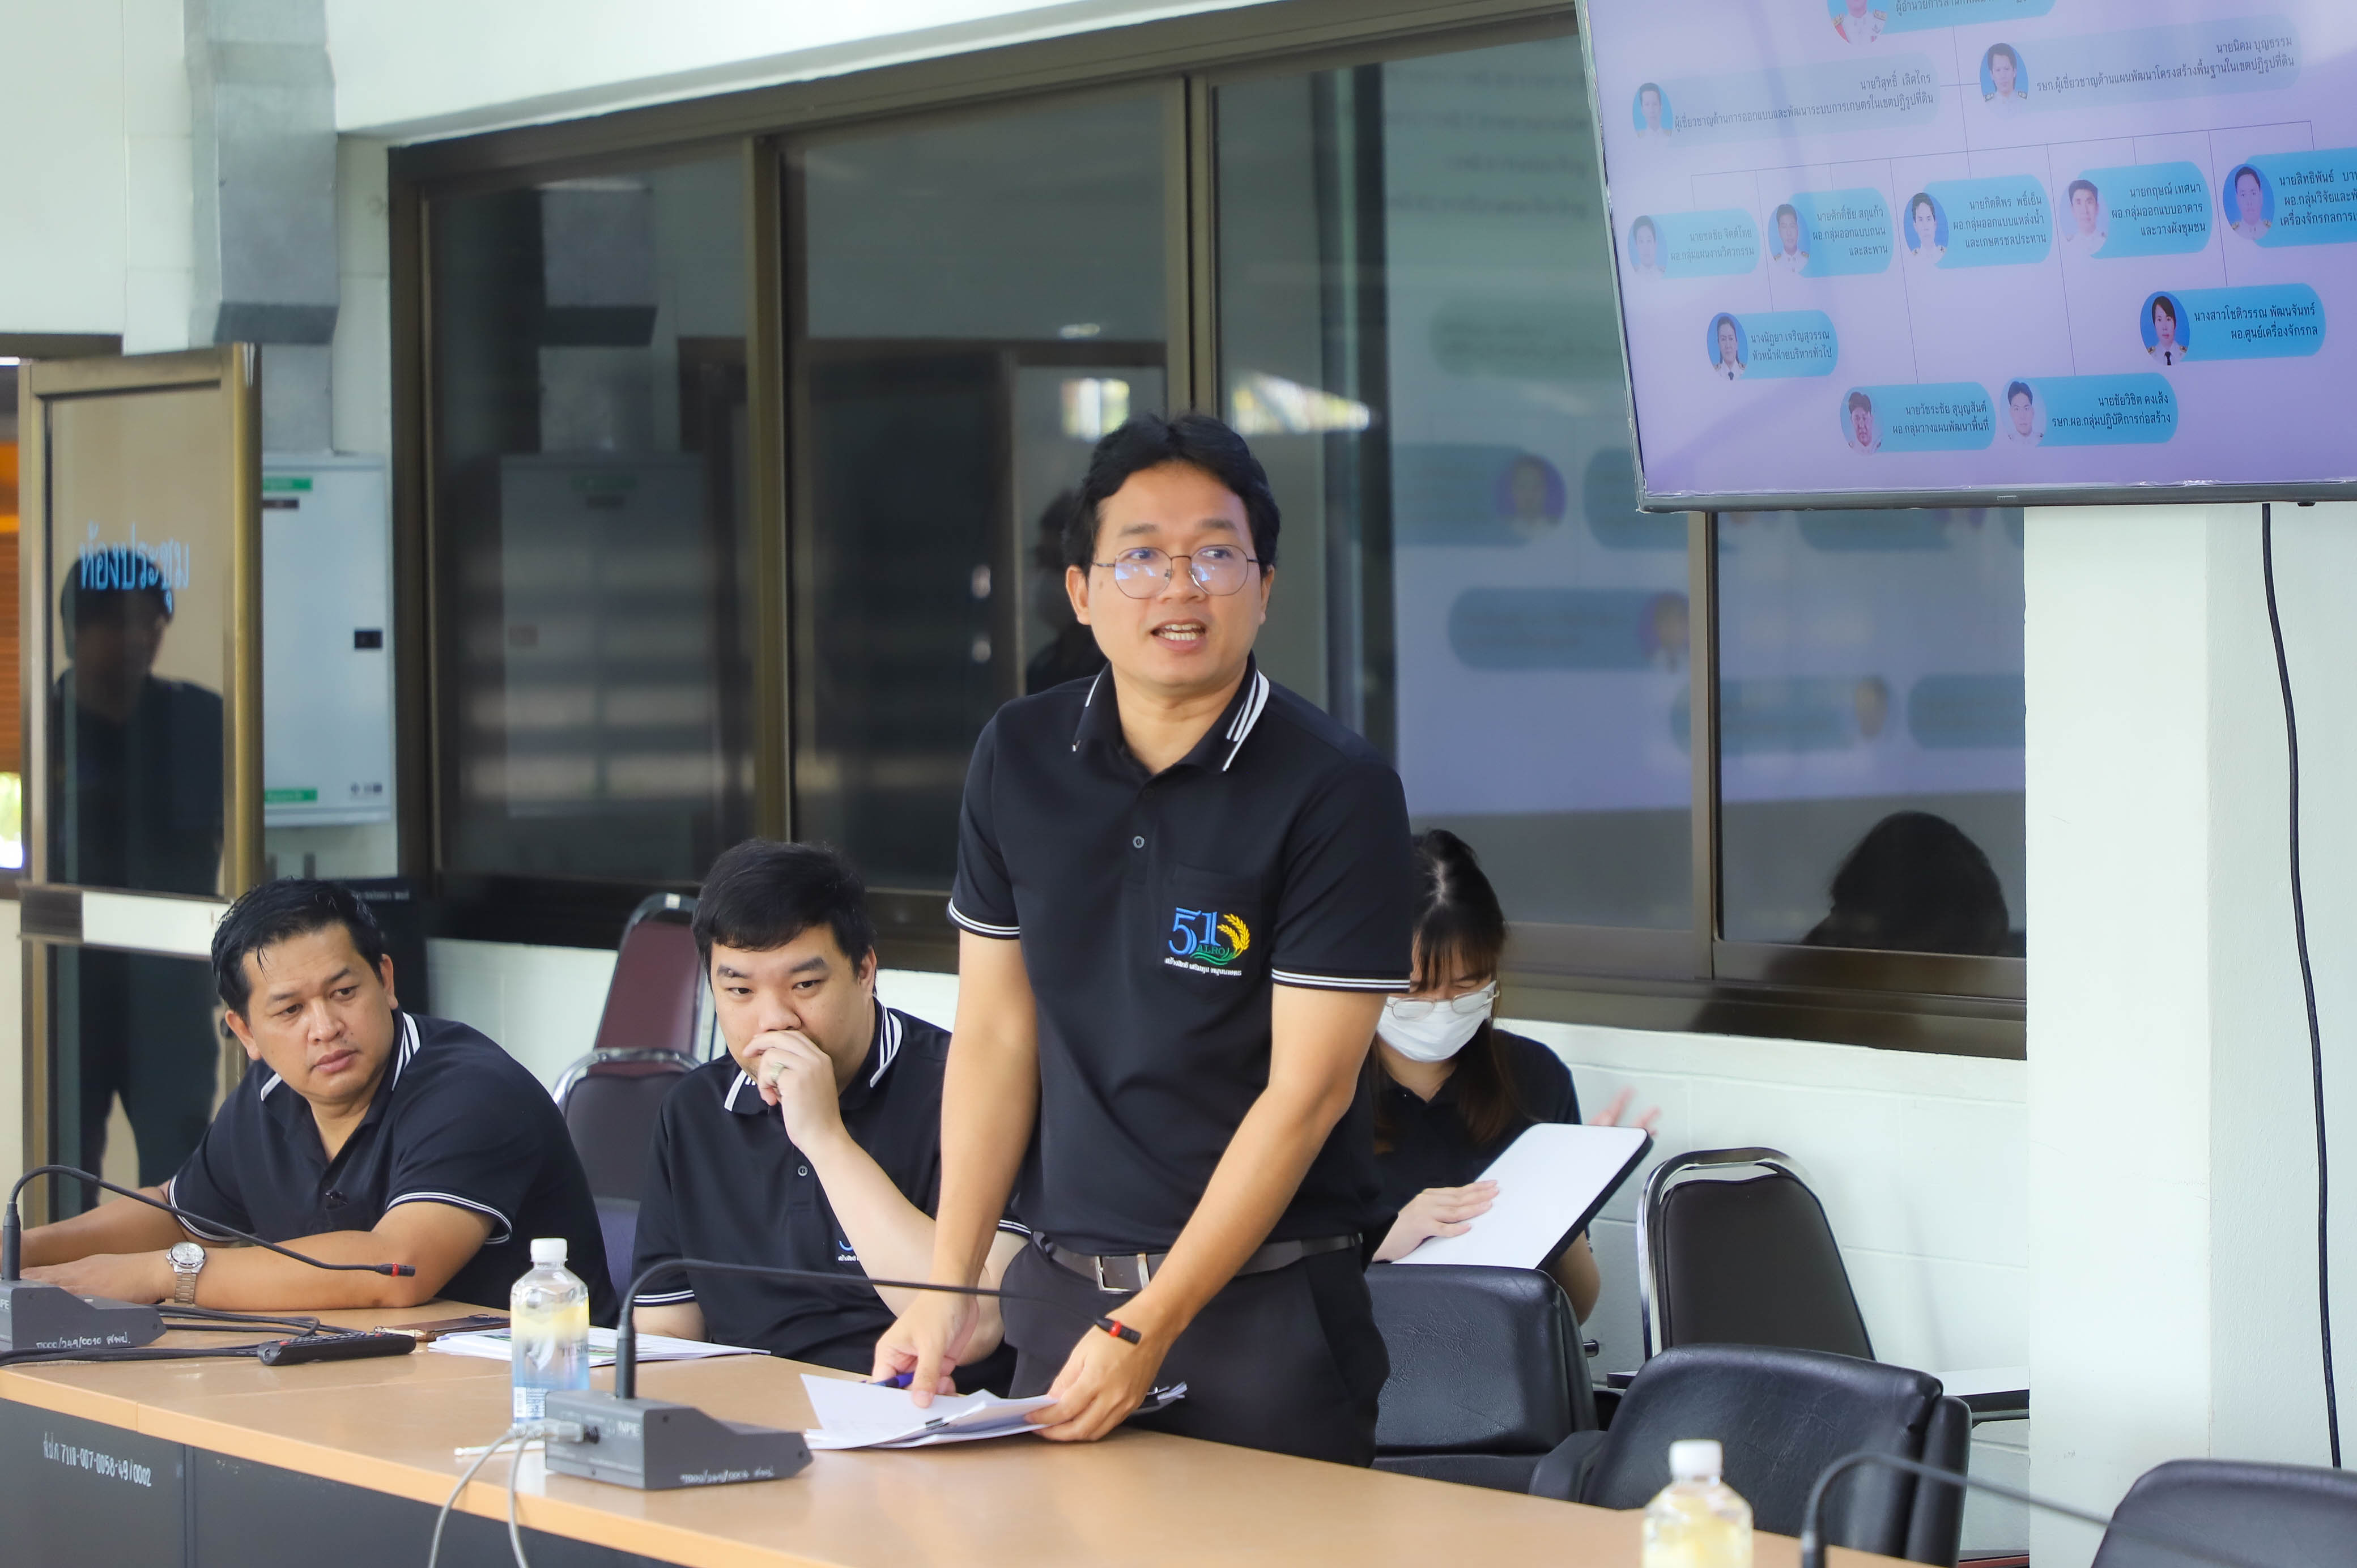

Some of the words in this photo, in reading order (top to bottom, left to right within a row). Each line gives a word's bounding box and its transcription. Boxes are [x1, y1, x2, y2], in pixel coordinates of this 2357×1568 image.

[2216, 39, 2252, 54] นายนิคม
[2254, 36, 2292, 53] บุญธรรม
[2130, 181, 2173, 199] นายกฤษณ์
[2175, 183, 2201, 195] เทศนา
[2284, 188, 2357, 208] ผอ.กลุ่มวิจัยและพั
[2280, 209, 2357, 226] เครื่องจักรกลการเ
[2141, 221, 2206, 237] และวางผังชุมชน
[1965, 233, 2047, 248] และเกษตรชลประทาน
[1849, 245, 1888, 256] และสะพาน
[2194, 304, 2267, 322] นางสาวโชติวรรณ
[2231, 321, 2318, 342] ผอ.ศูนย์เครื่องจักรกล
[79, 519, 190, 614] ห้องประชุม
[1168, 907, 1221, 956] 51
[1196, 944, 1226, 956] ALRO
